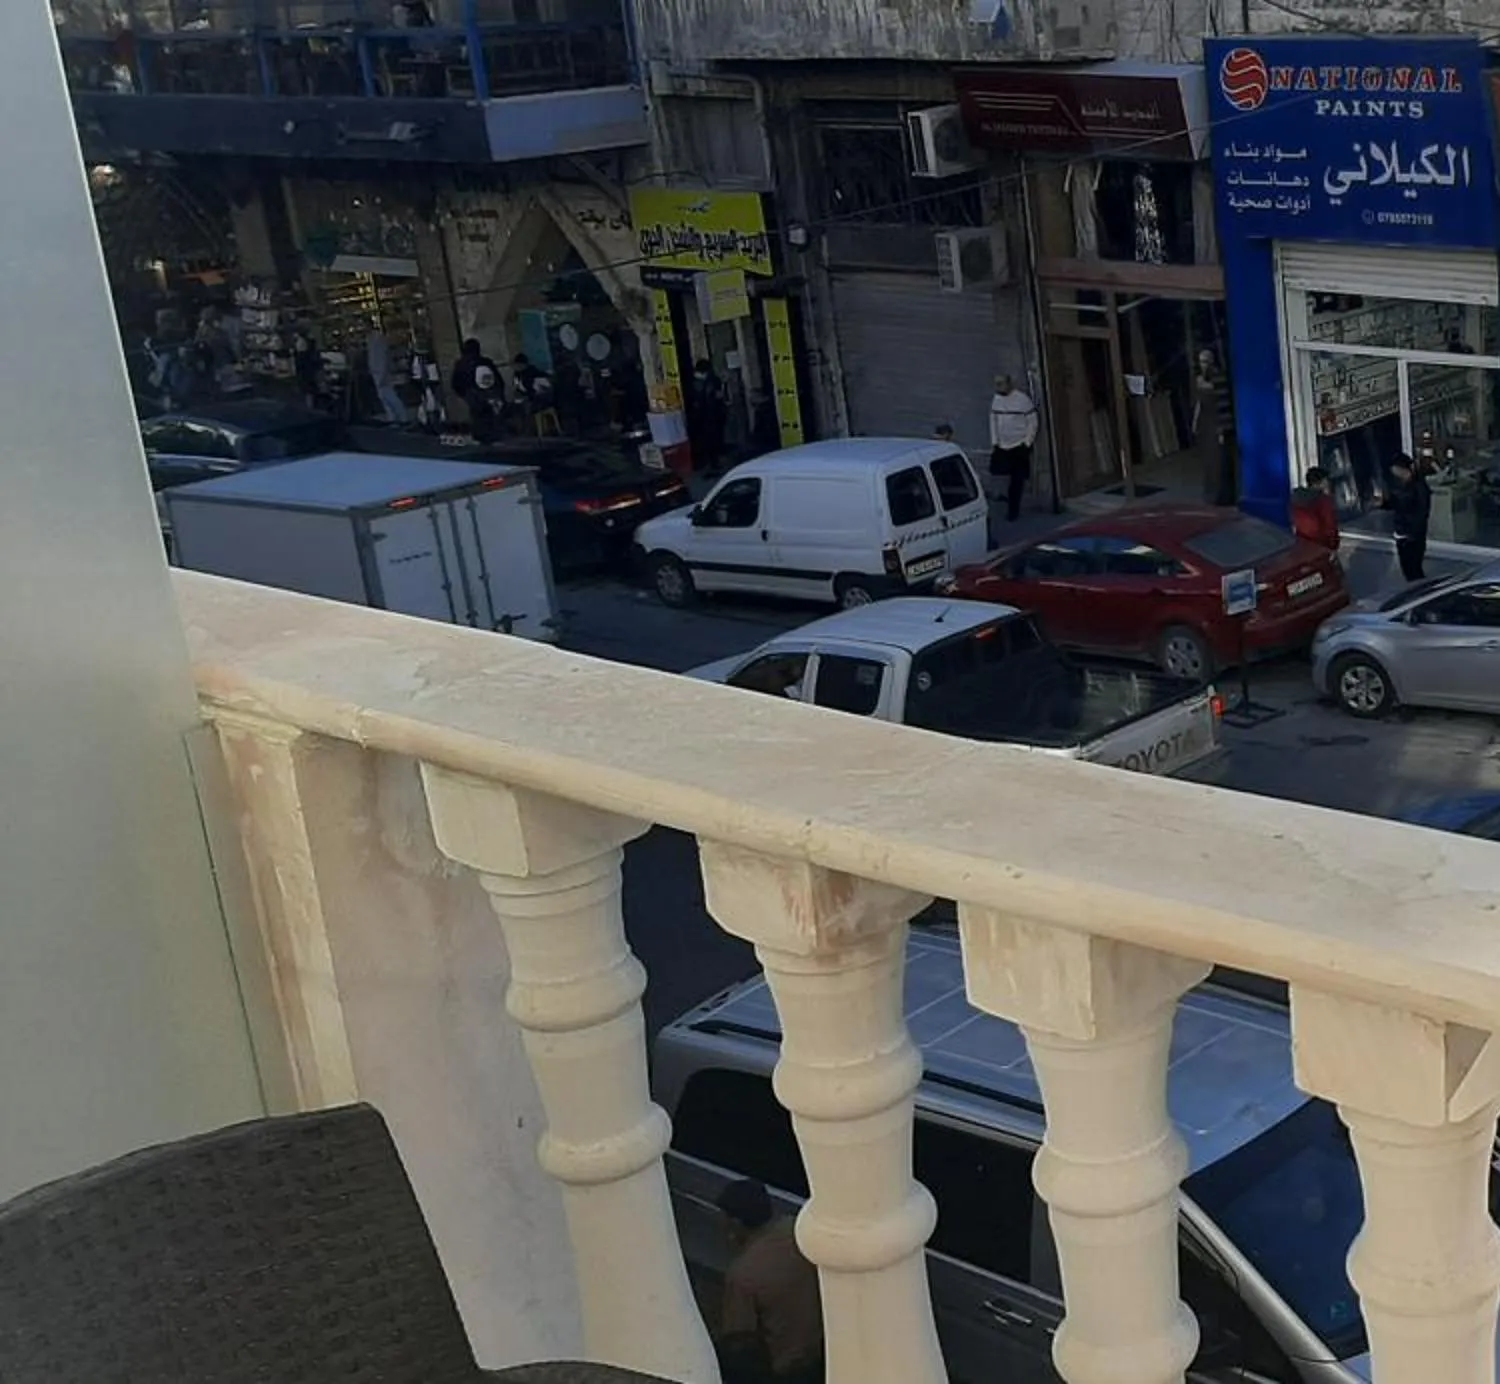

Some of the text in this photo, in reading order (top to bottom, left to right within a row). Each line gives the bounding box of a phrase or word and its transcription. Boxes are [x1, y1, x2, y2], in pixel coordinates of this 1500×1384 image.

[1270, 65, 1462, 93] NATIONAL
[1315, 99, 1424, 119] PAINTS
[1224, 142, 1307, 163] مواد بناء
[1323, 140, 1470, 206] الكيلاني
[1228, 194, 1311, 215] أدوات صحية
[1117, 729, 1197, 773] OYOTA
